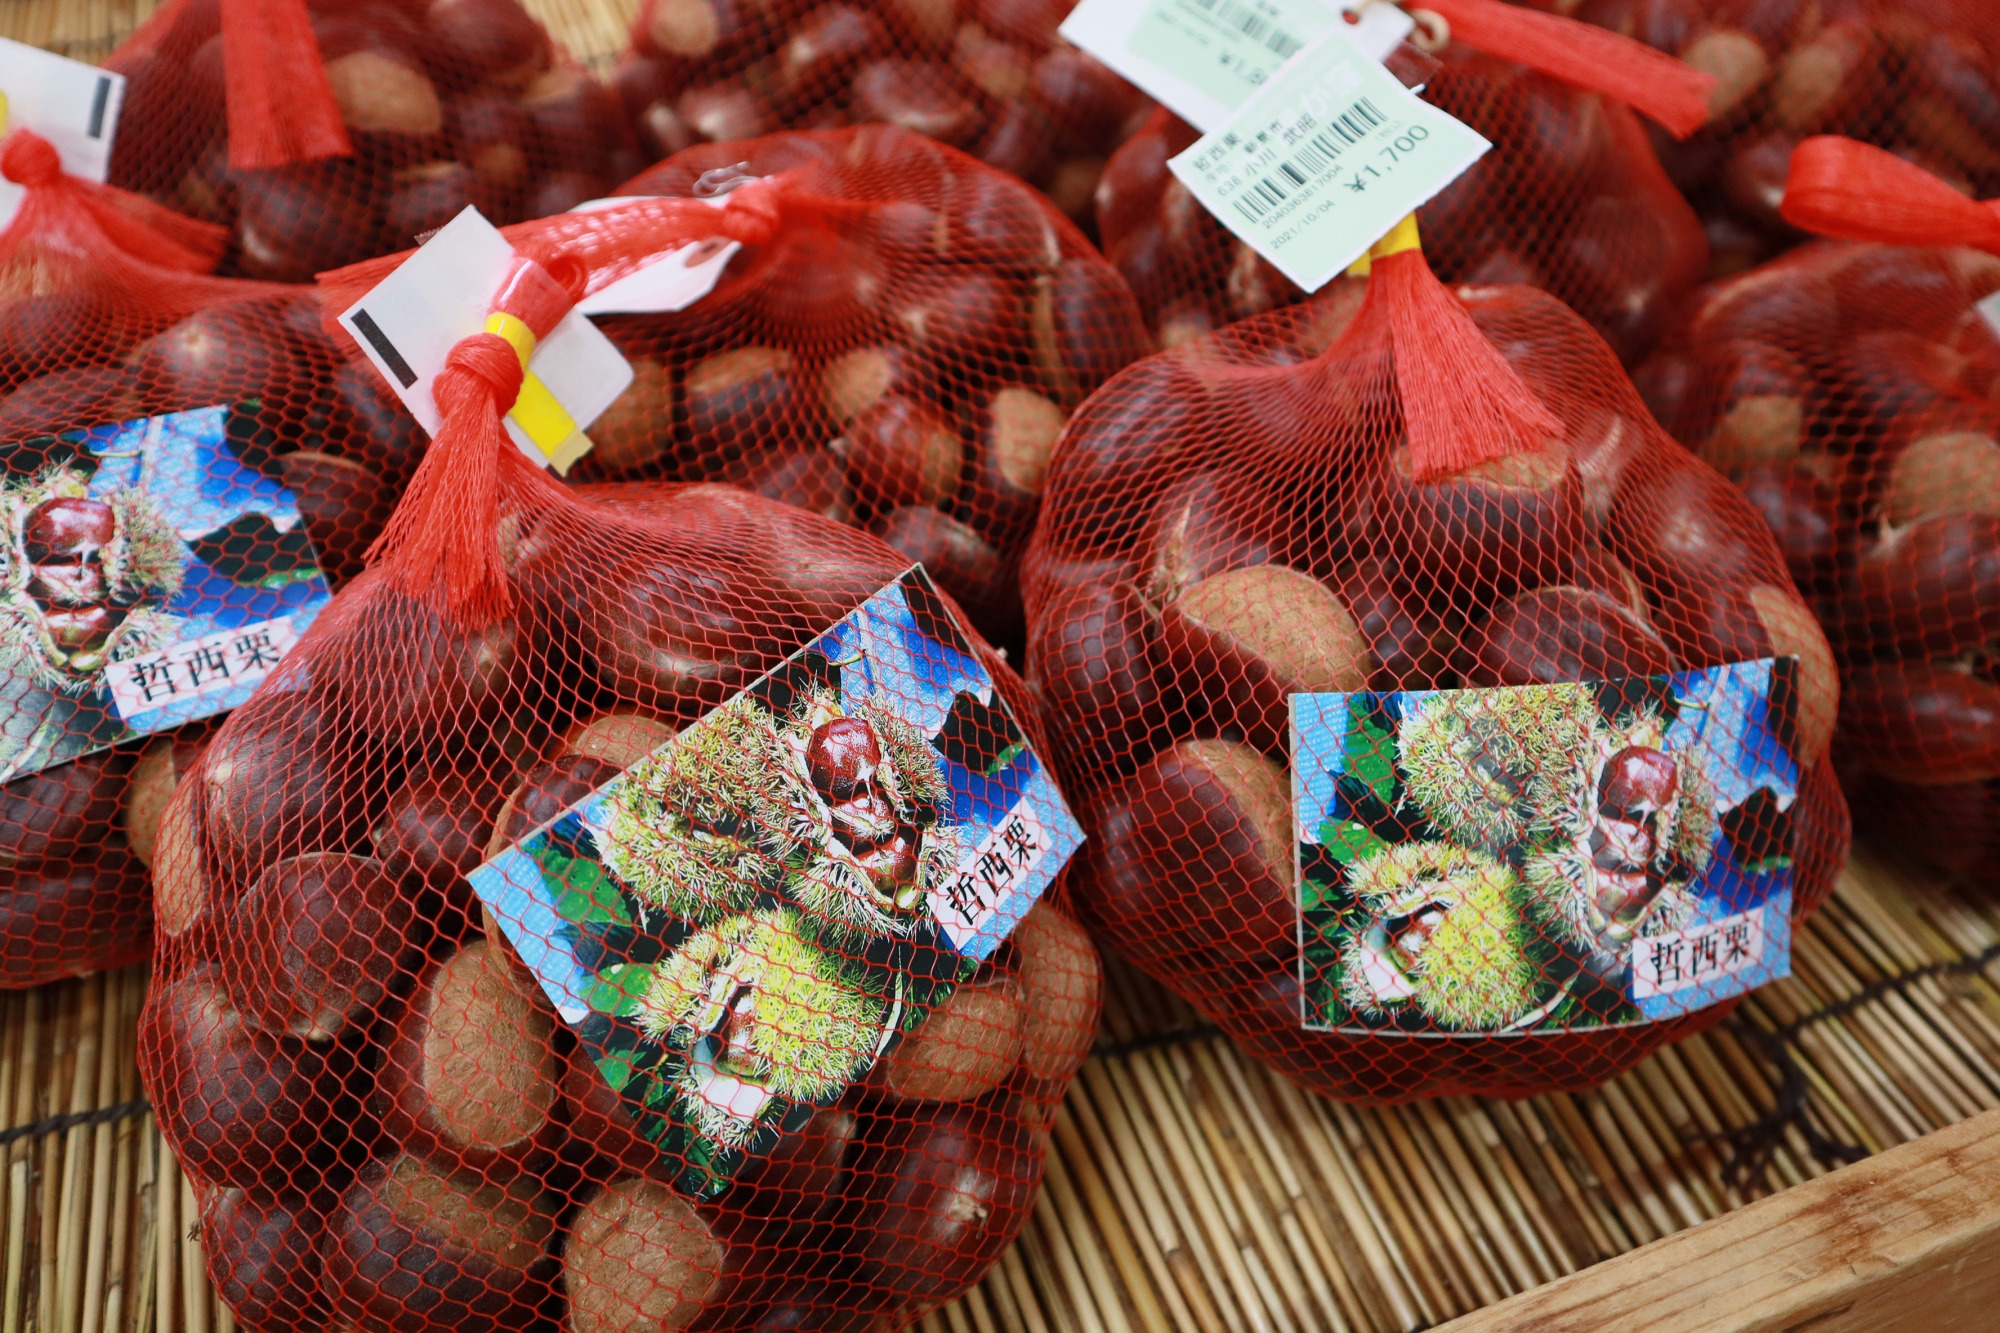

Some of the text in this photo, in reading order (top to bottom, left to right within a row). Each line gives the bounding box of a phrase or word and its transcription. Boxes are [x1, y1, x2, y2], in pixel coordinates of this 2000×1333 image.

[1192, 131, 1241, 172] 哲西栗
[1244, 147, 1278, 177] 小川
[1282, 112, 1317, 146] 武昭
[1343, 125, 1430, 192] ¥1,700
[1261, 163, 1343, 229] 2040363817004
[1270, 199, 1335, 250] 2021/10/04
[131, 629, 281, 702] 哲西栗
[945, 815, 1037, 926] 哲西栗
[1650, 918, 1750, 986] 哲西栗
